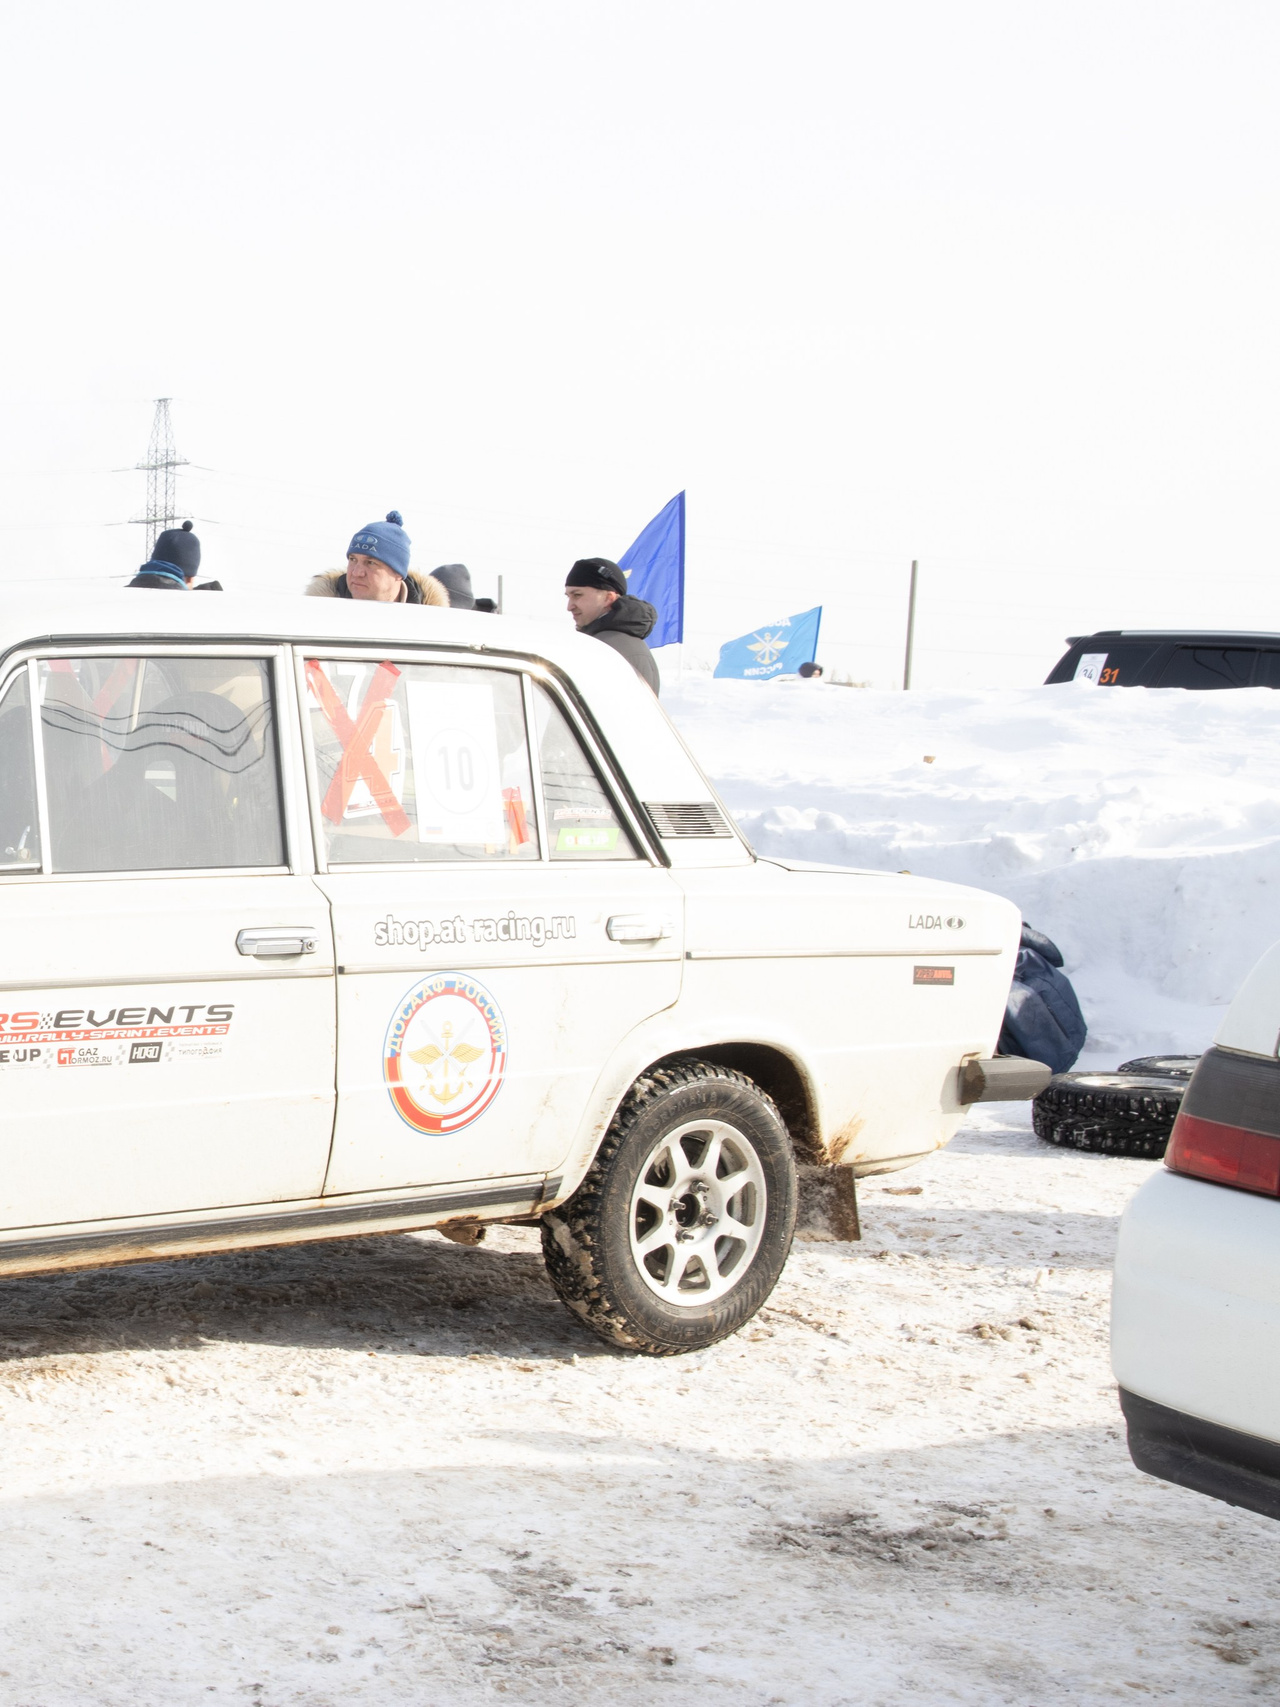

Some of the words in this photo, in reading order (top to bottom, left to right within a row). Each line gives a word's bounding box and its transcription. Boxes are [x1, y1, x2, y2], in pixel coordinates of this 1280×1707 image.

[1100, 668, 1120, 684] 31
[437, 745, 475, 792] 10
[908, 914, 942, 930] LADA
[53, 1004, 236, 1029] EVENTS
[387, 977, 446, 1053] ДОСААФ
[454, 977, 506, 1048] РОССИИ
[78, 1048, 99, 1056] GAZ
